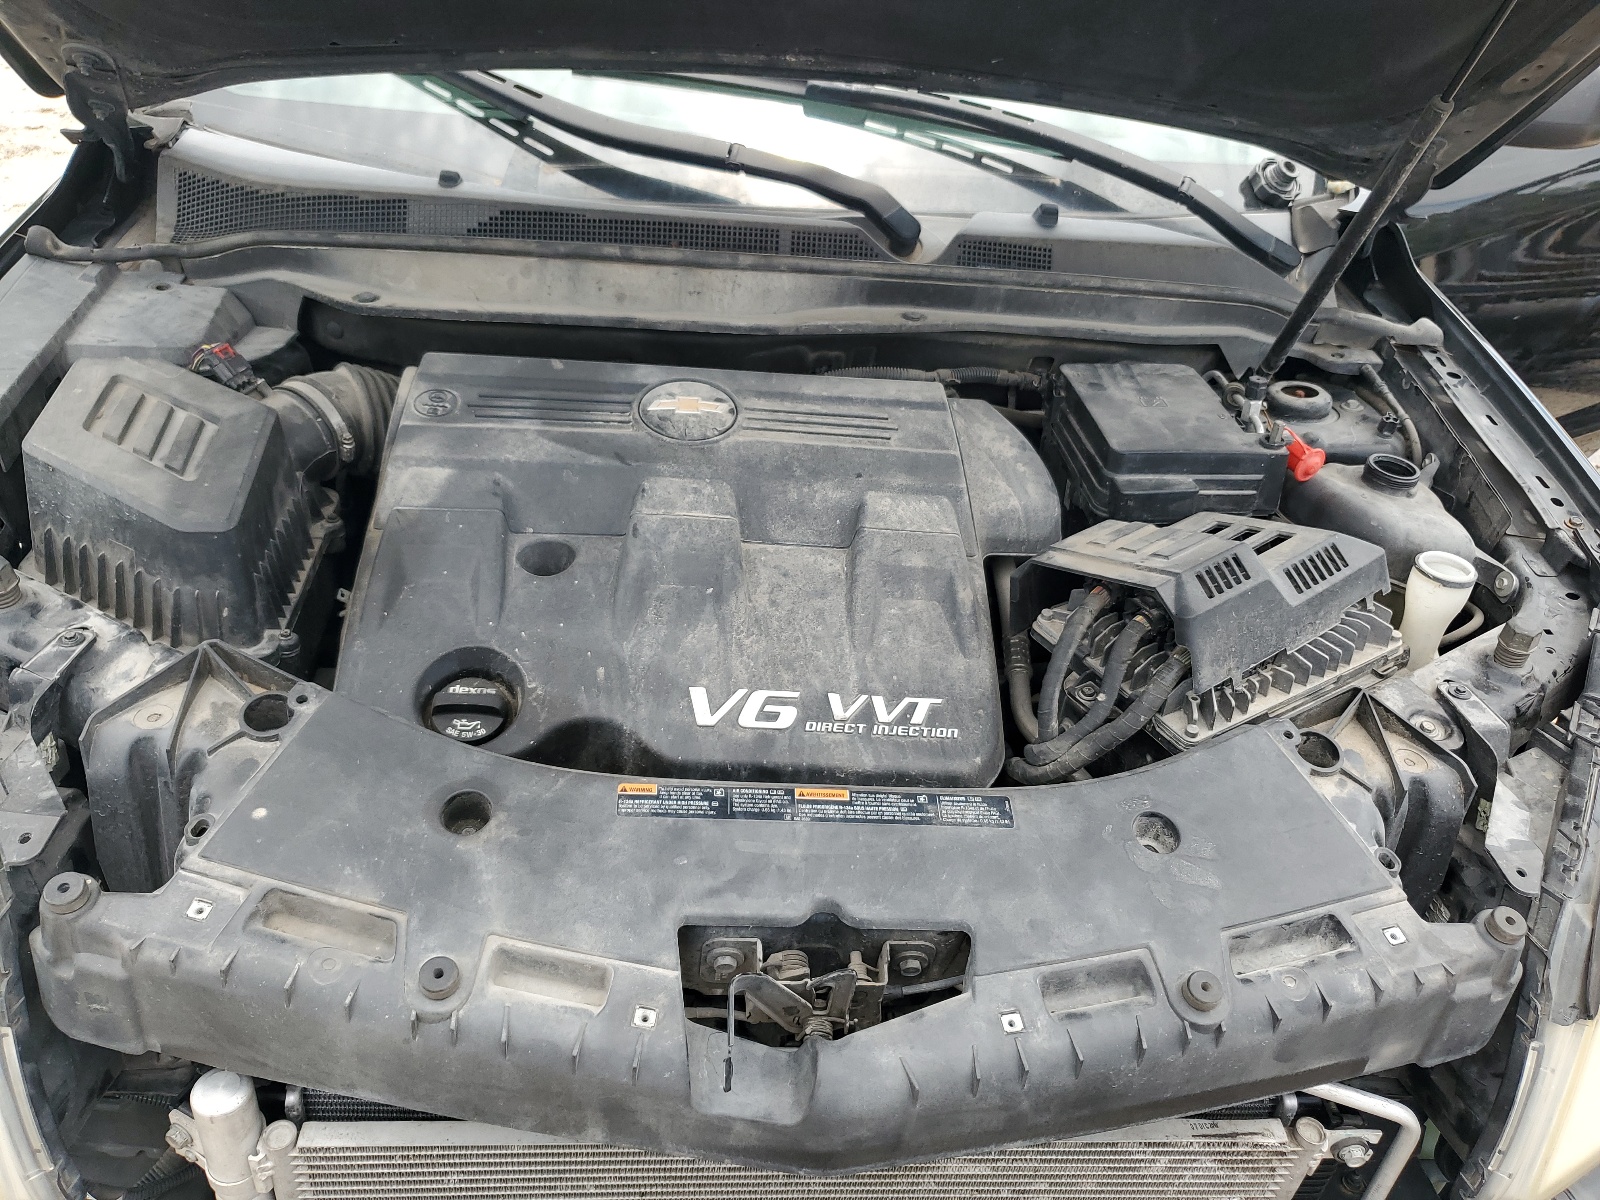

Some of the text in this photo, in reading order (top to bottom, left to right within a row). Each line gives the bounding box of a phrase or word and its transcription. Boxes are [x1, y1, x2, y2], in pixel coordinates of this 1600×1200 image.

[689, 686, 942, 730] V6 VVT
[445, 726, 460, 737] SAE
[805, 721, 958, 738] DIRECT INJECTION
